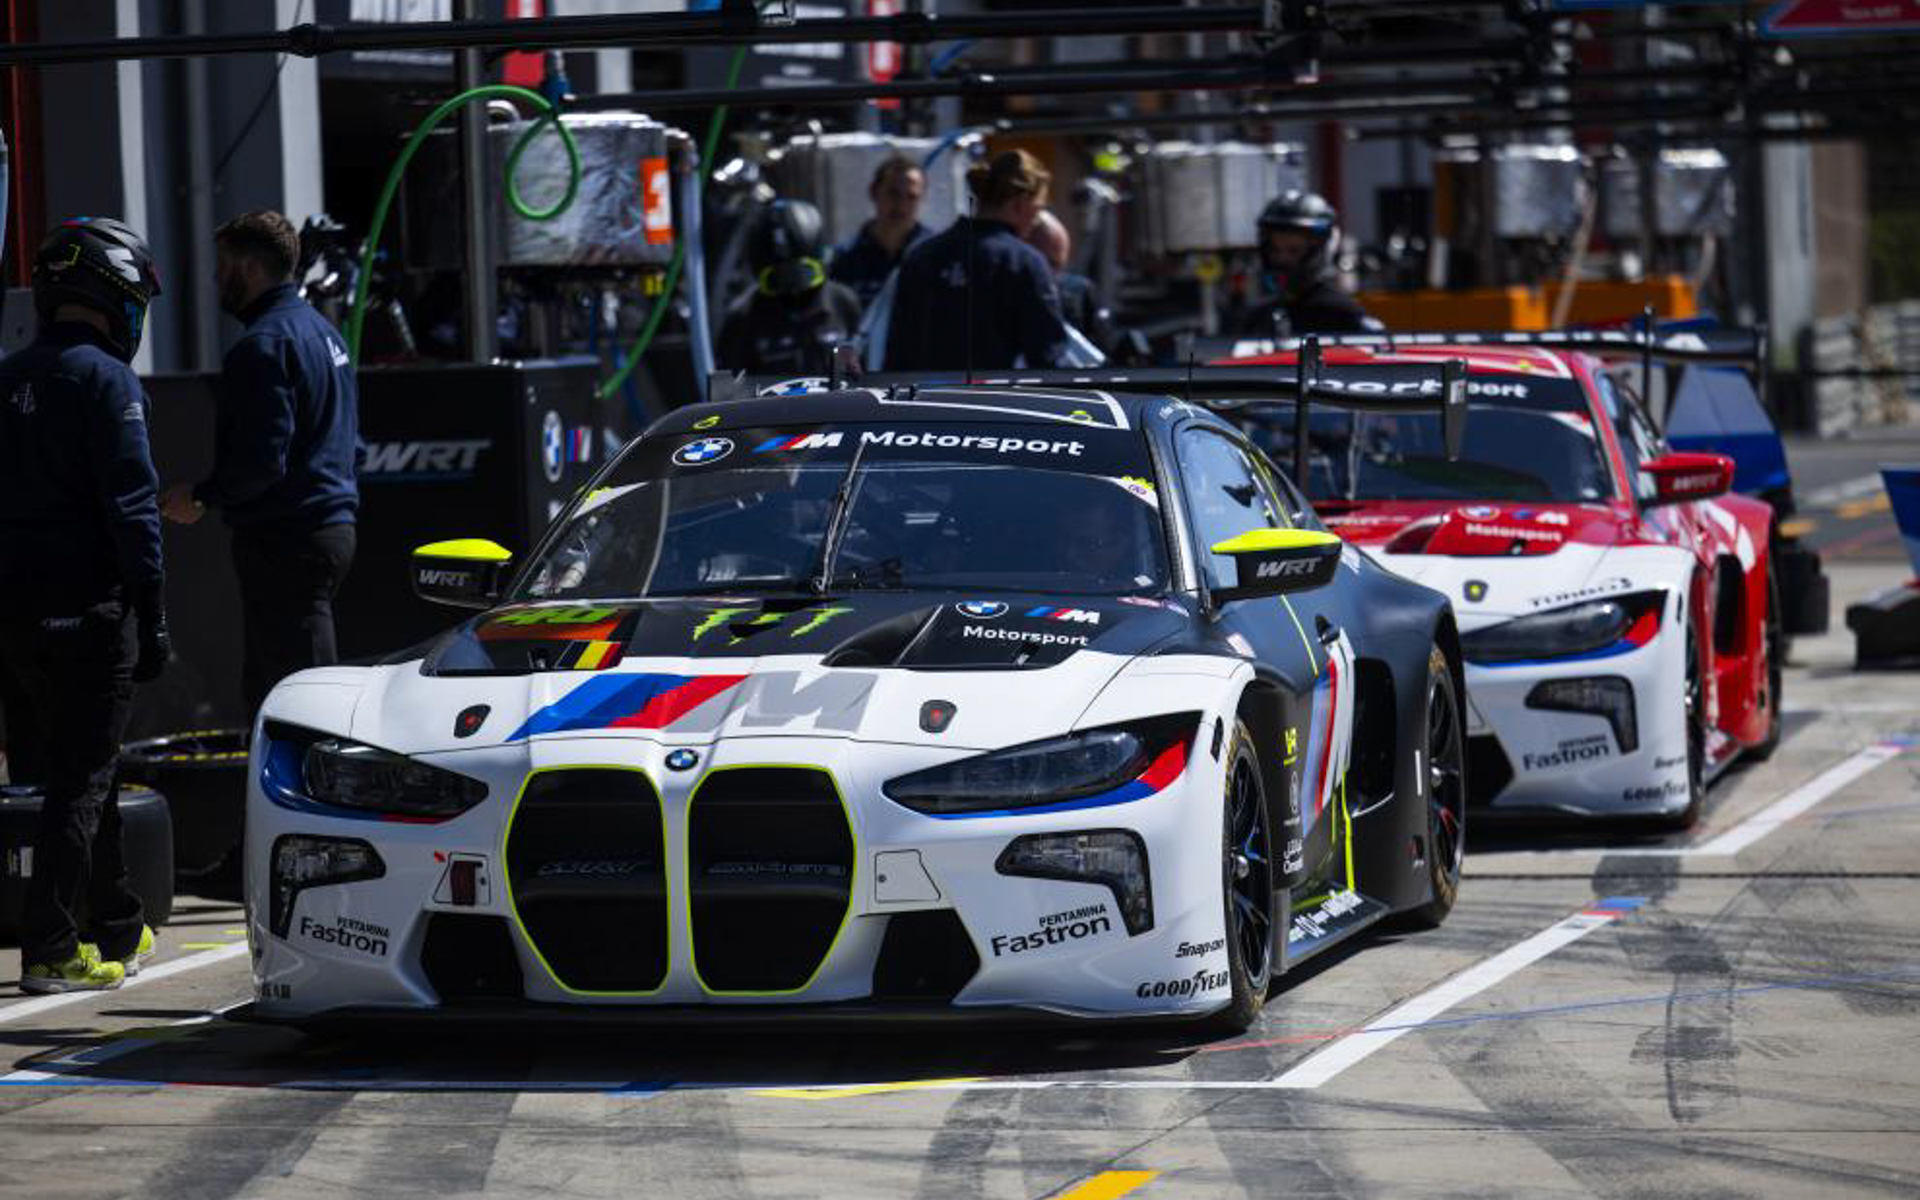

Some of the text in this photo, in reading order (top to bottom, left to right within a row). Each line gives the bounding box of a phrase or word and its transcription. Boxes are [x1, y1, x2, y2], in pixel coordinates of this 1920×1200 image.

[362, 439, 493, 472] WRT
[861, 431, 1086, 457] Motorsport
[1465, 522, 1562, 543] Motorsport
[418, 569, 470, 587] WRT
[1256, 556, 1322, 578] WRT
[962, 625, 1090, 647] Motorsport
[1521, 744, 1610, 771] Fastron
[337, 917, 390, 939] PERTAMINA
[1038, 904, 1107, 928] PERTAMINA
[299, 917, 389, 957] Fastron
[991, 916, 1111, 957] Fastron
